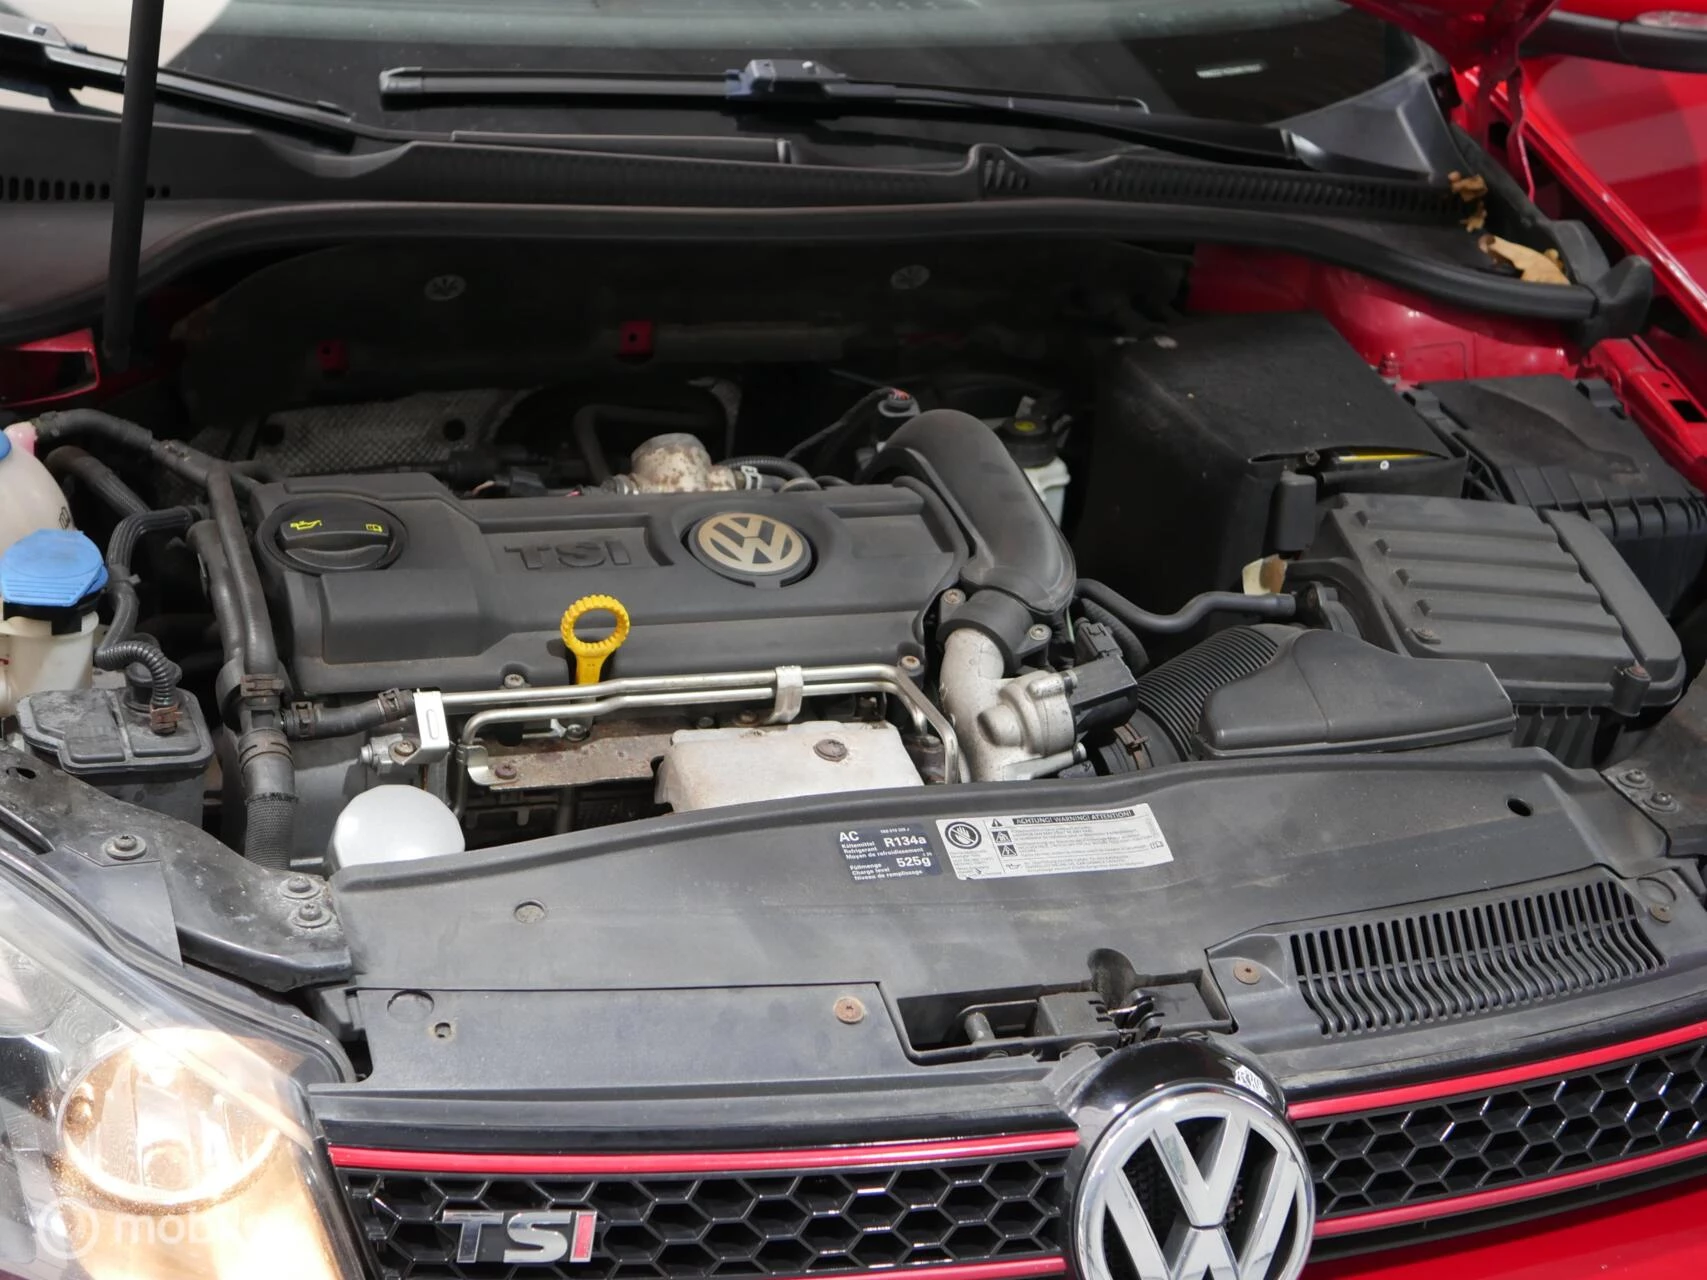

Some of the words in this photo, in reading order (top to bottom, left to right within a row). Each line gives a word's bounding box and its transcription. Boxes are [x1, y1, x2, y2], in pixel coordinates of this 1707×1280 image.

[504, 540, 631, 570] TSI
[1055, 814, 1090, 823] WARNING!
[1091, 810, 1132, 821] ATTENTION!
[839, 830, 860, 842] AC
[883, 835, 927, 848] R134a
[896, 856, 932, 868] 525g
[852, 868, 875, 876] Charge
[442, 1210, 598, 1264] TSI
